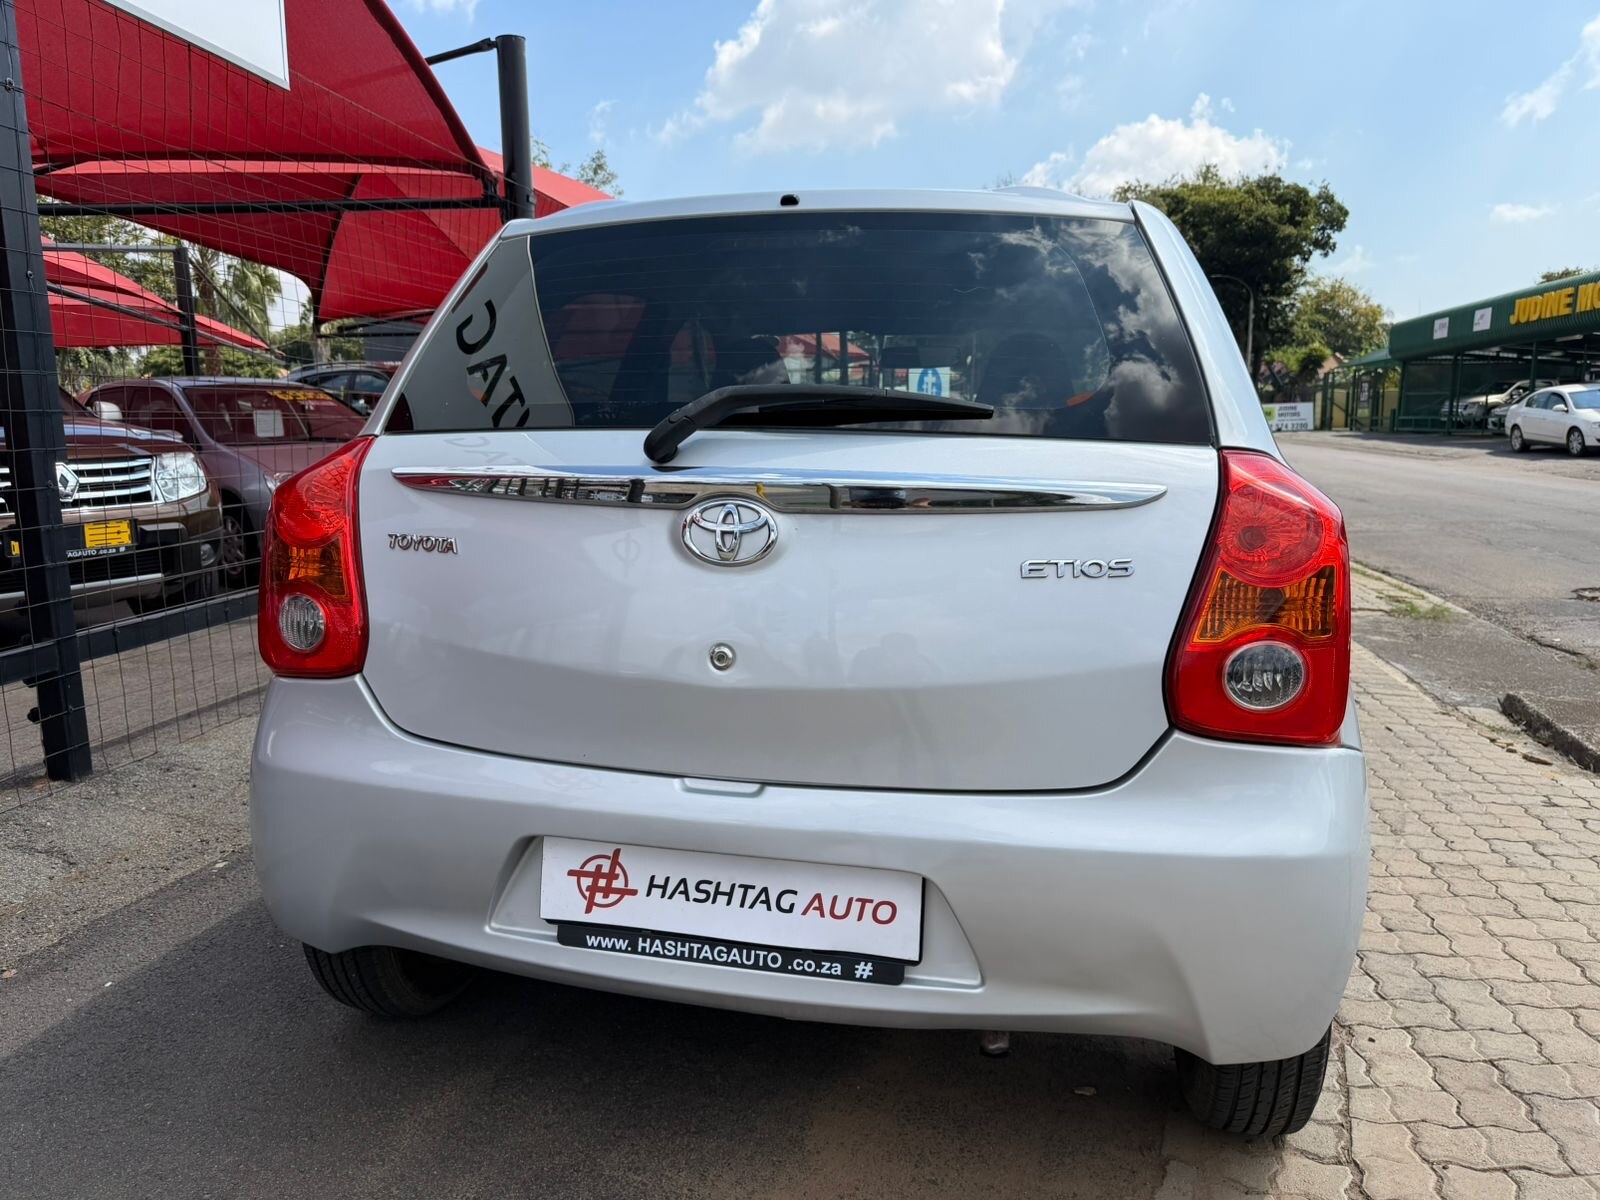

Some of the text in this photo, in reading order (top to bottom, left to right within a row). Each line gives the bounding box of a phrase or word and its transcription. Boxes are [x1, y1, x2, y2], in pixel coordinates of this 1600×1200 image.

[1510, 287, 1575, 325] JUDINE
[66, 549, 97, 558] AGAUTO
[387, 532, 458, 554] TOYOTA
[1020, 558, 1136, 579] ETIOS
[645, 873, 898, 926] HASHTAG AUTO
[585, 934, 632, 952] www.
[637, 937, 782, 969] HASHTAGAUTO
[786, 957, 842, 977] .co.za
